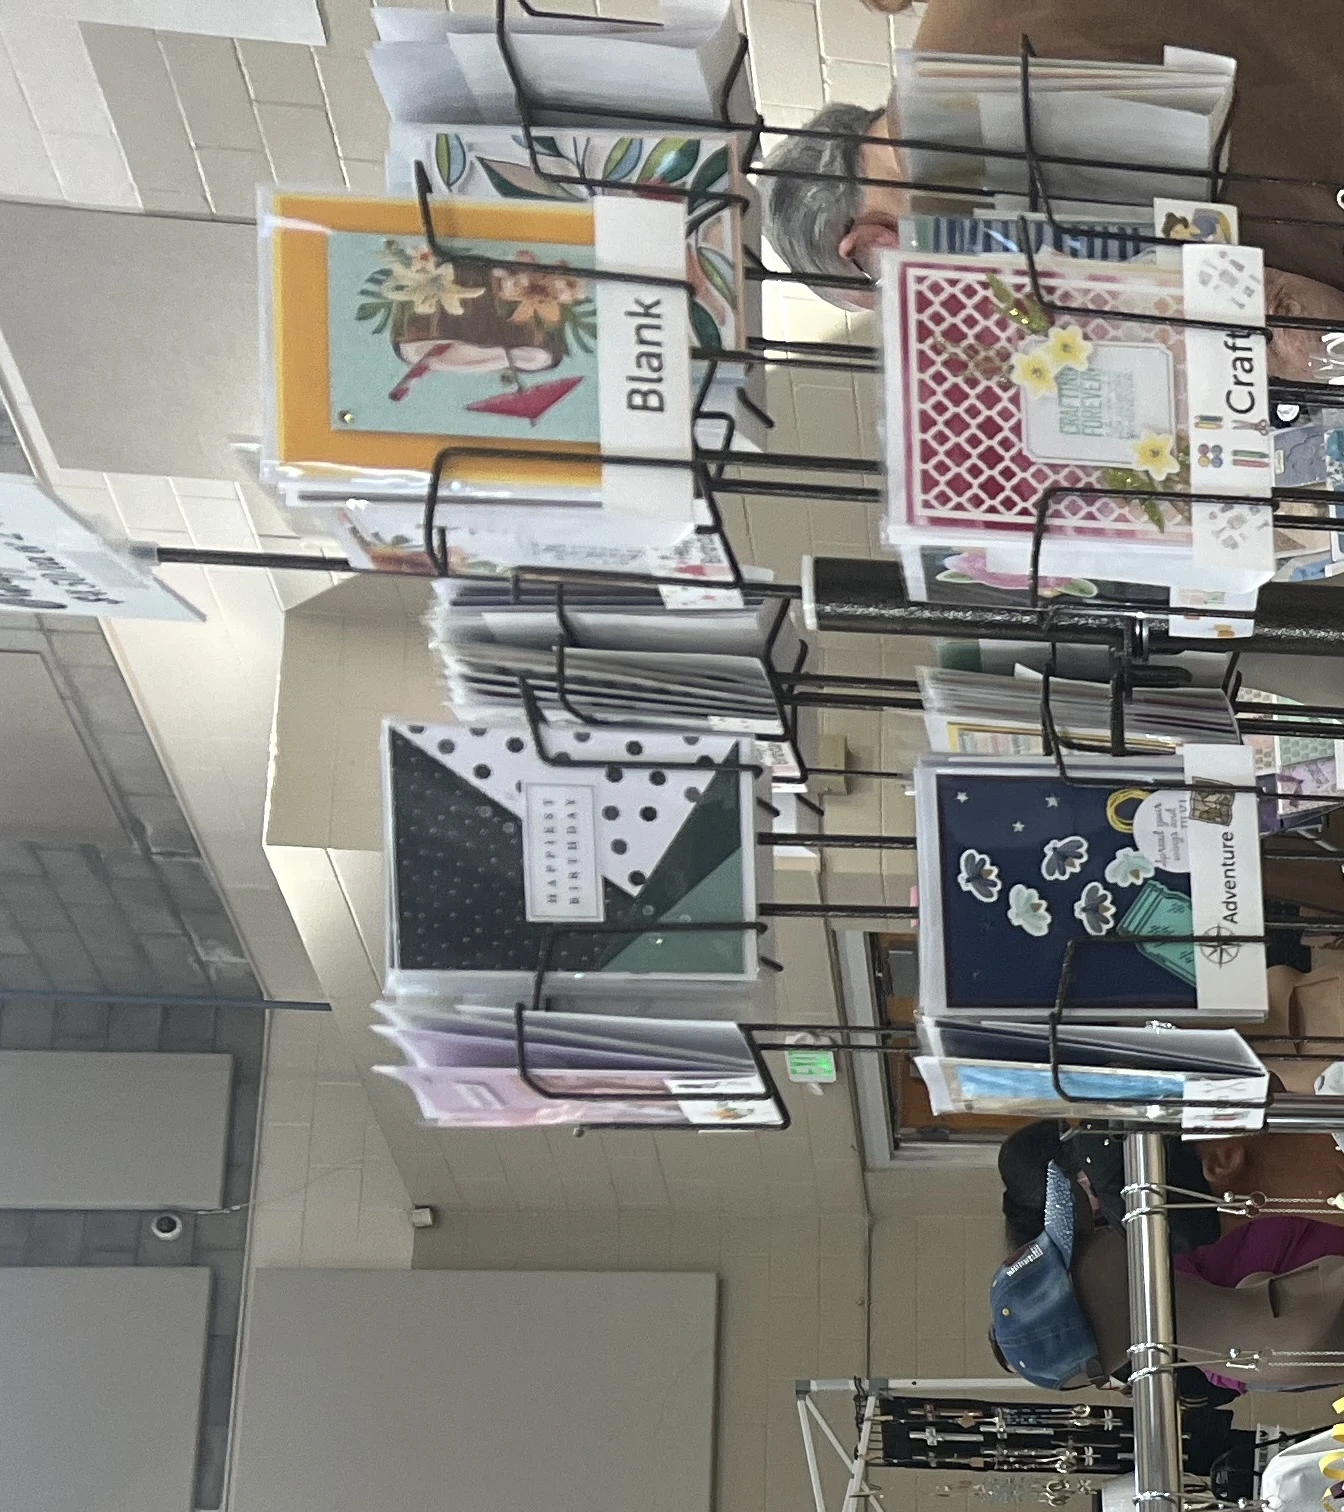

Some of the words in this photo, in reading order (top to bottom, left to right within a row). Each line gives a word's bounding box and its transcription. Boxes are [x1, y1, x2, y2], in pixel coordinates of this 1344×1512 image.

[625, 298, 664, 413] Blank
[1225, 329, 1257, 414] Craft
[543, 799, 557, 903] HAPPIEST
[565, 799, 580, 904] BIRTHDAY
[1219, 831, 1239, 924] Adventure
